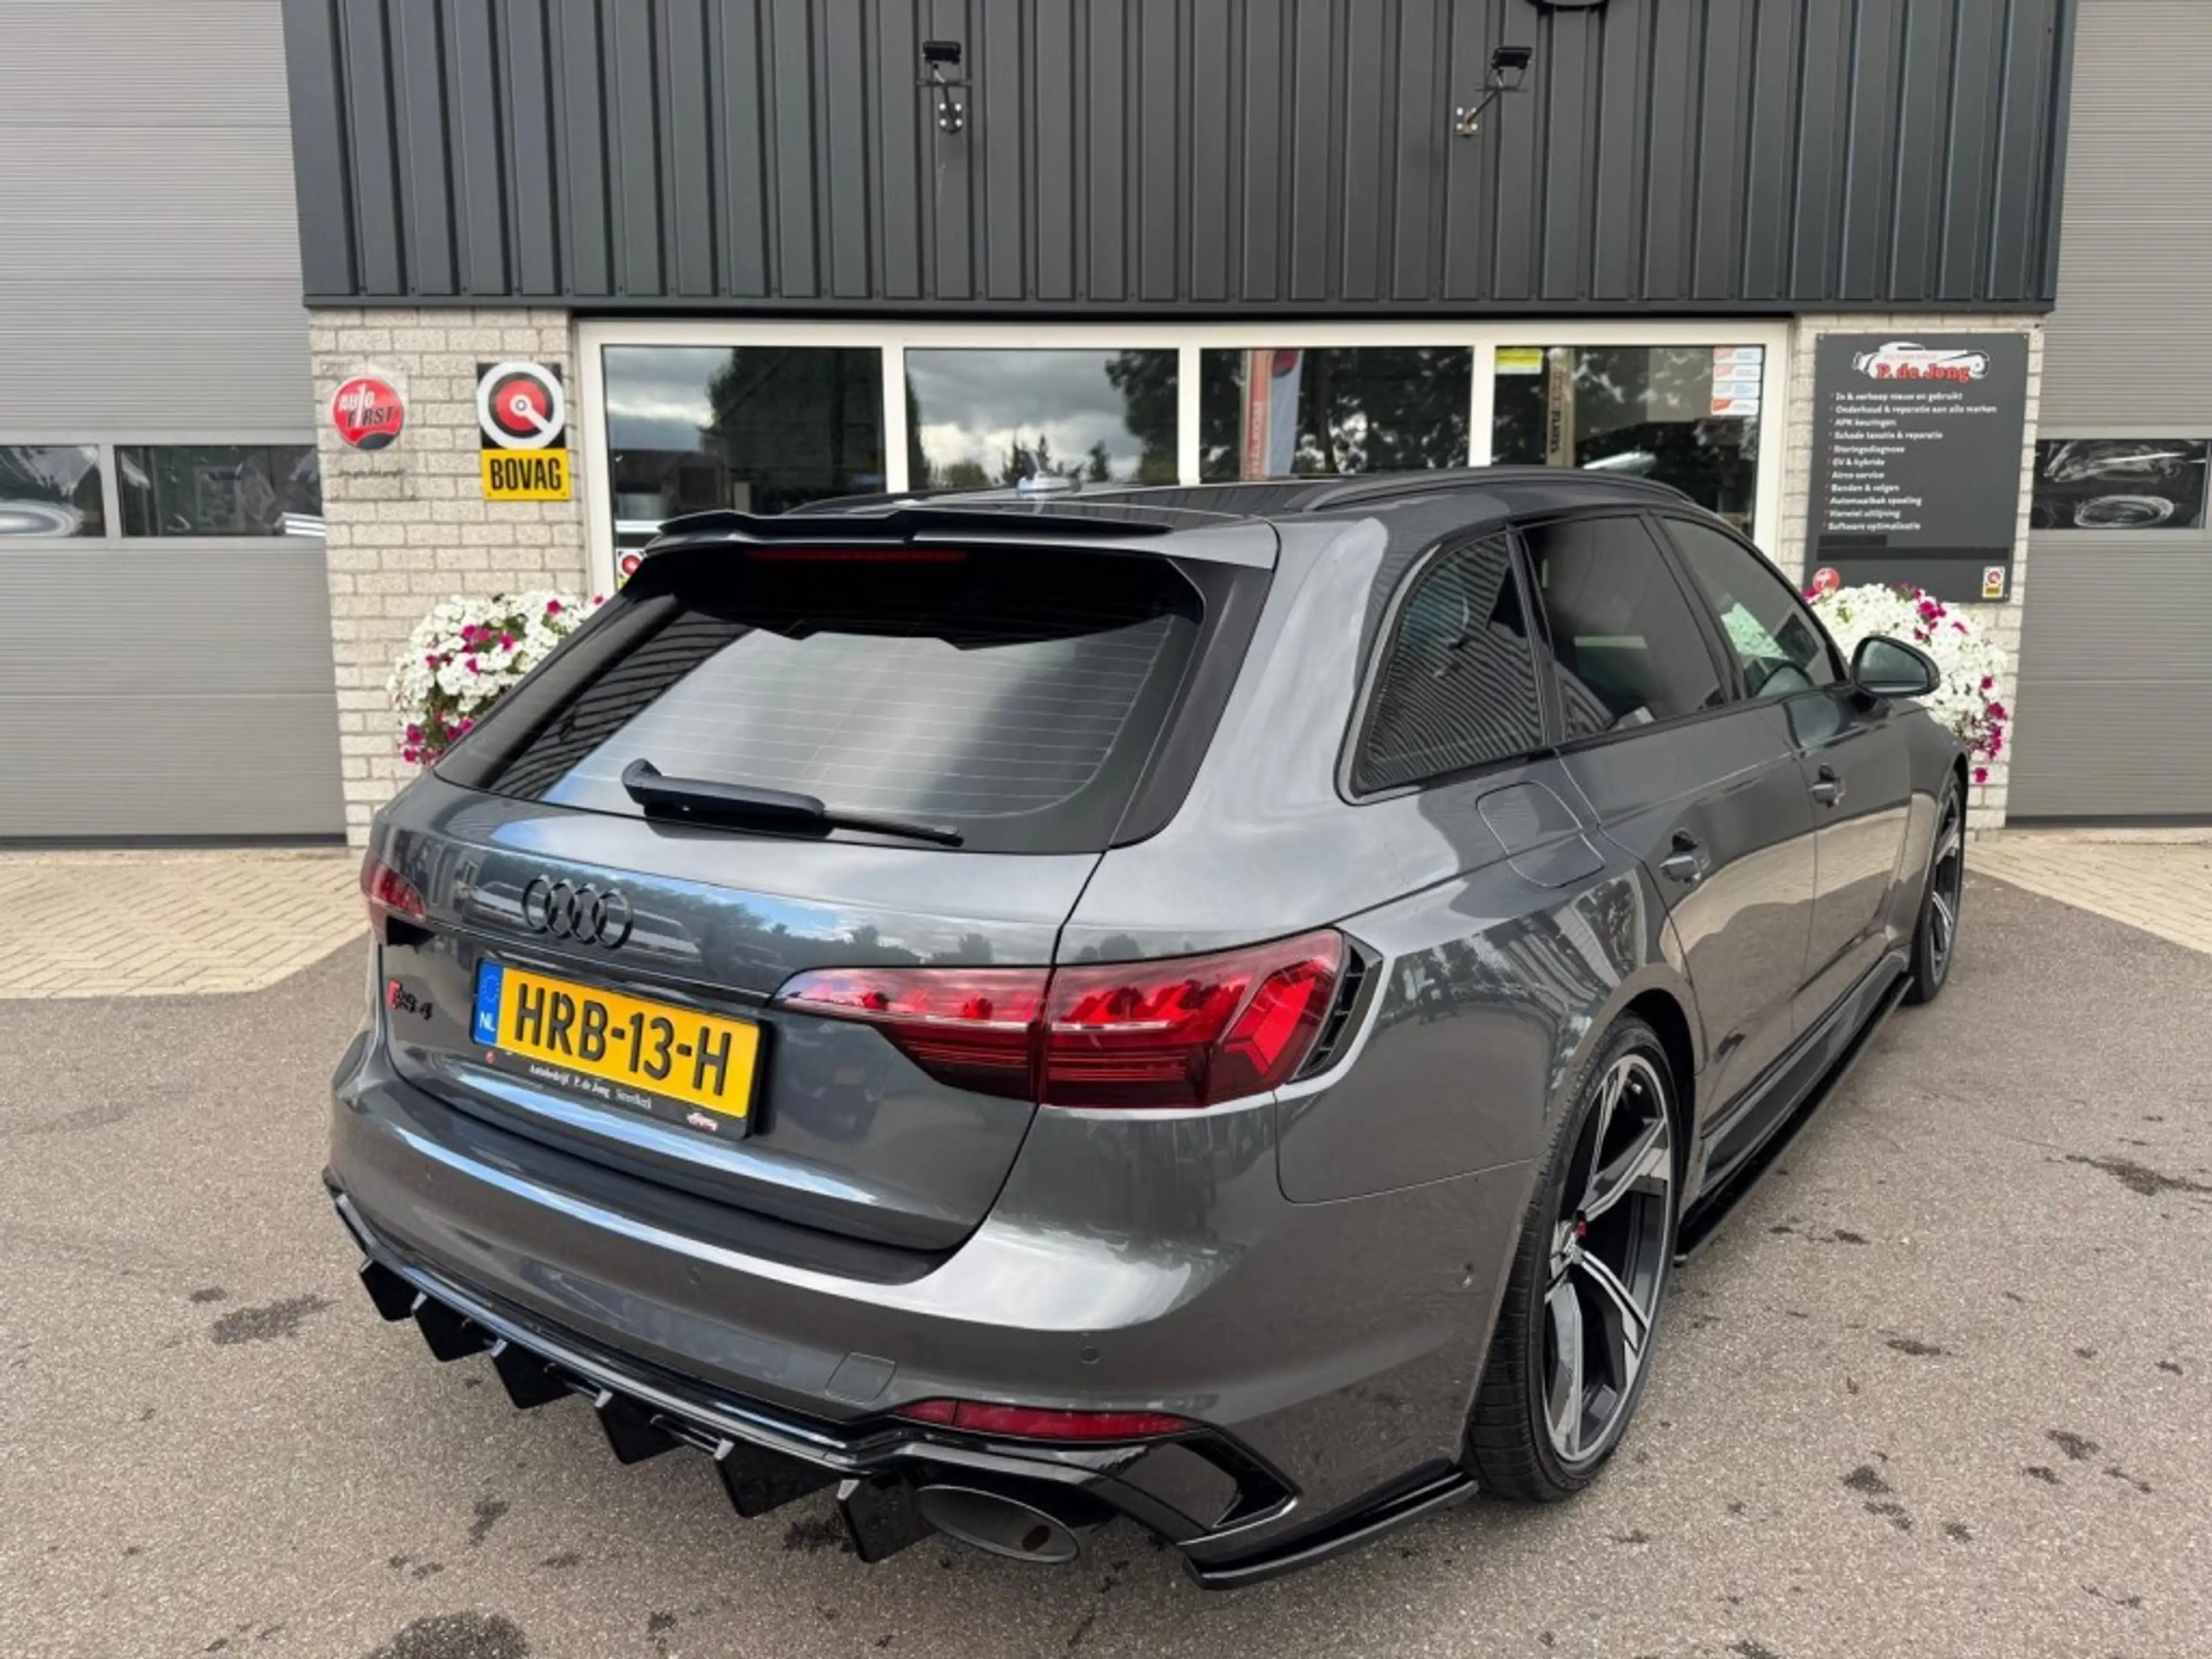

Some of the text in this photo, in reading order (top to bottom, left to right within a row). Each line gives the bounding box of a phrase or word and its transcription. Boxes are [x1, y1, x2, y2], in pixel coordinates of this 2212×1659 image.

[1896, 363, 1920, 380] de
[1922, 362, 1971, 383] Jong
[1855, 392, 1888, 403] verkoop
[1929, 391, 1963, 403] gebruikt
[1835, 404, 1883, 414] Onderhoud
[1892, 404, 1930, 415] reparatie
[1965, 404, 1998, 414] merken
[1855, 418, 1897, 429] keuringen
[489, 457, 562, 491] BOVAG
[479, 1010, 496, 1032] NL
[514, 982, 732, 1096] HRB-13-H
